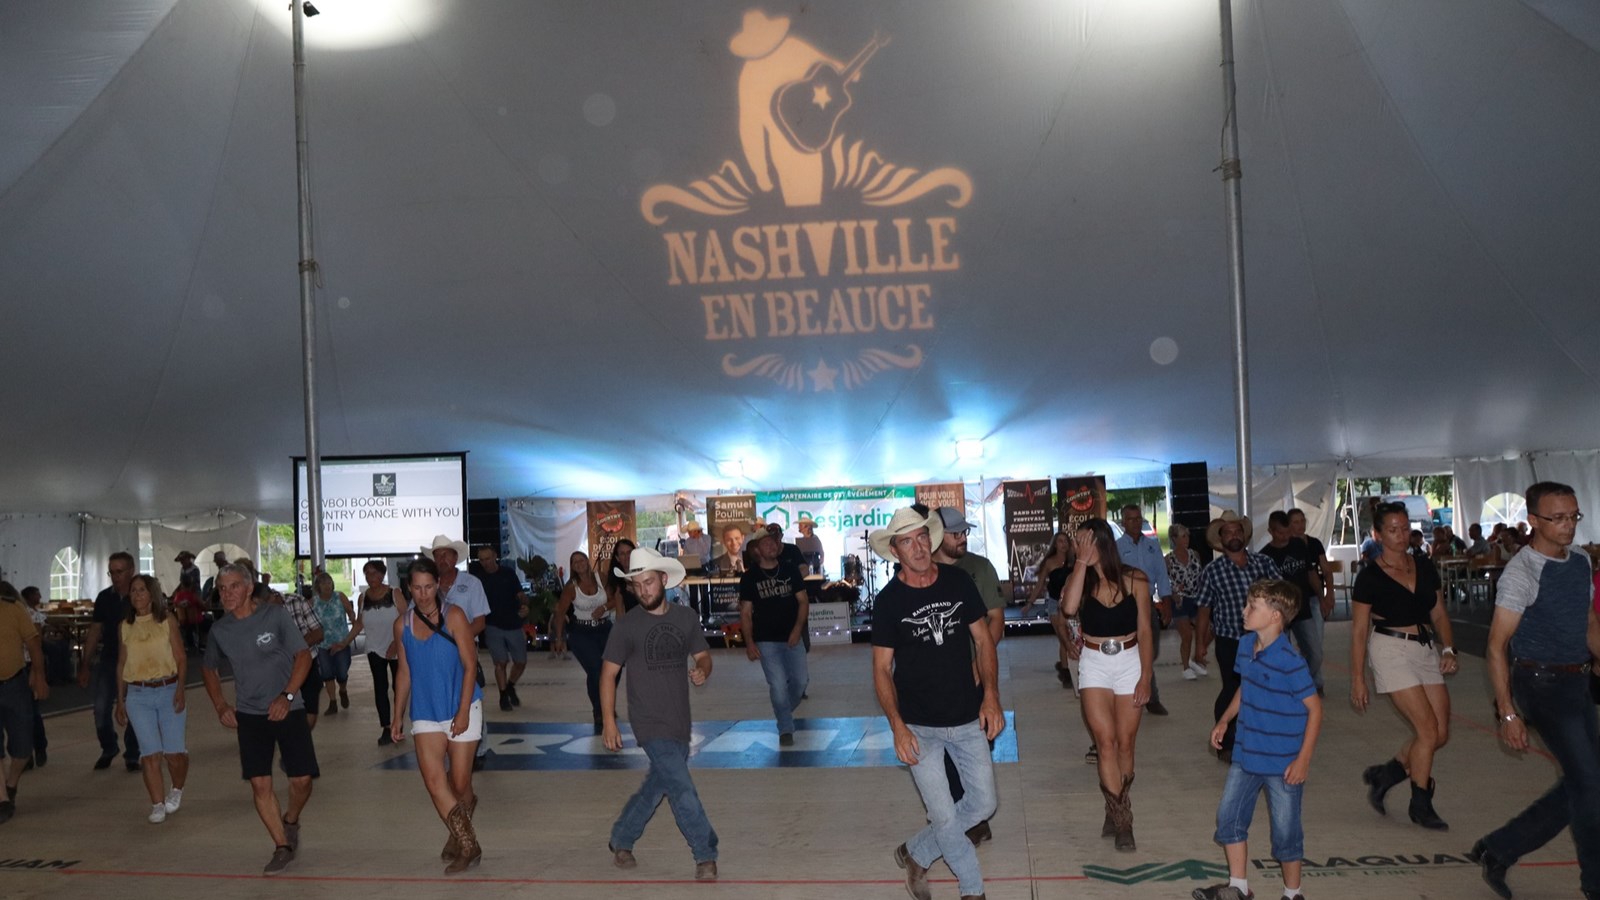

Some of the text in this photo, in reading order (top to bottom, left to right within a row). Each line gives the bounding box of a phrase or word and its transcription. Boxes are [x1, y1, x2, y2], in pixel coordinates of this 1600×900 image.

[663, 217, 960, 285] NASHVILLE
[701, 284, 934, 340] EN BEAUCE
[300, 496, 395, 510] CWBOI BOOGIE
[919, 490, 955, 501] POUR VOUS
[714, 499, 752, 510] Samuel
[300, 506, 460, 522] CNTRY DANCE WITH YOU
[715, 509, 744, 519] Poulin
[797, 508, 893, 532] Desjardin
[300, 522, 344, 533] BTIN
[756, 578, 777, 591] KEEP
[912, 601, 952, 617] RANCH BRAND
[1250, 853, 1481, 869] DAAQUA
